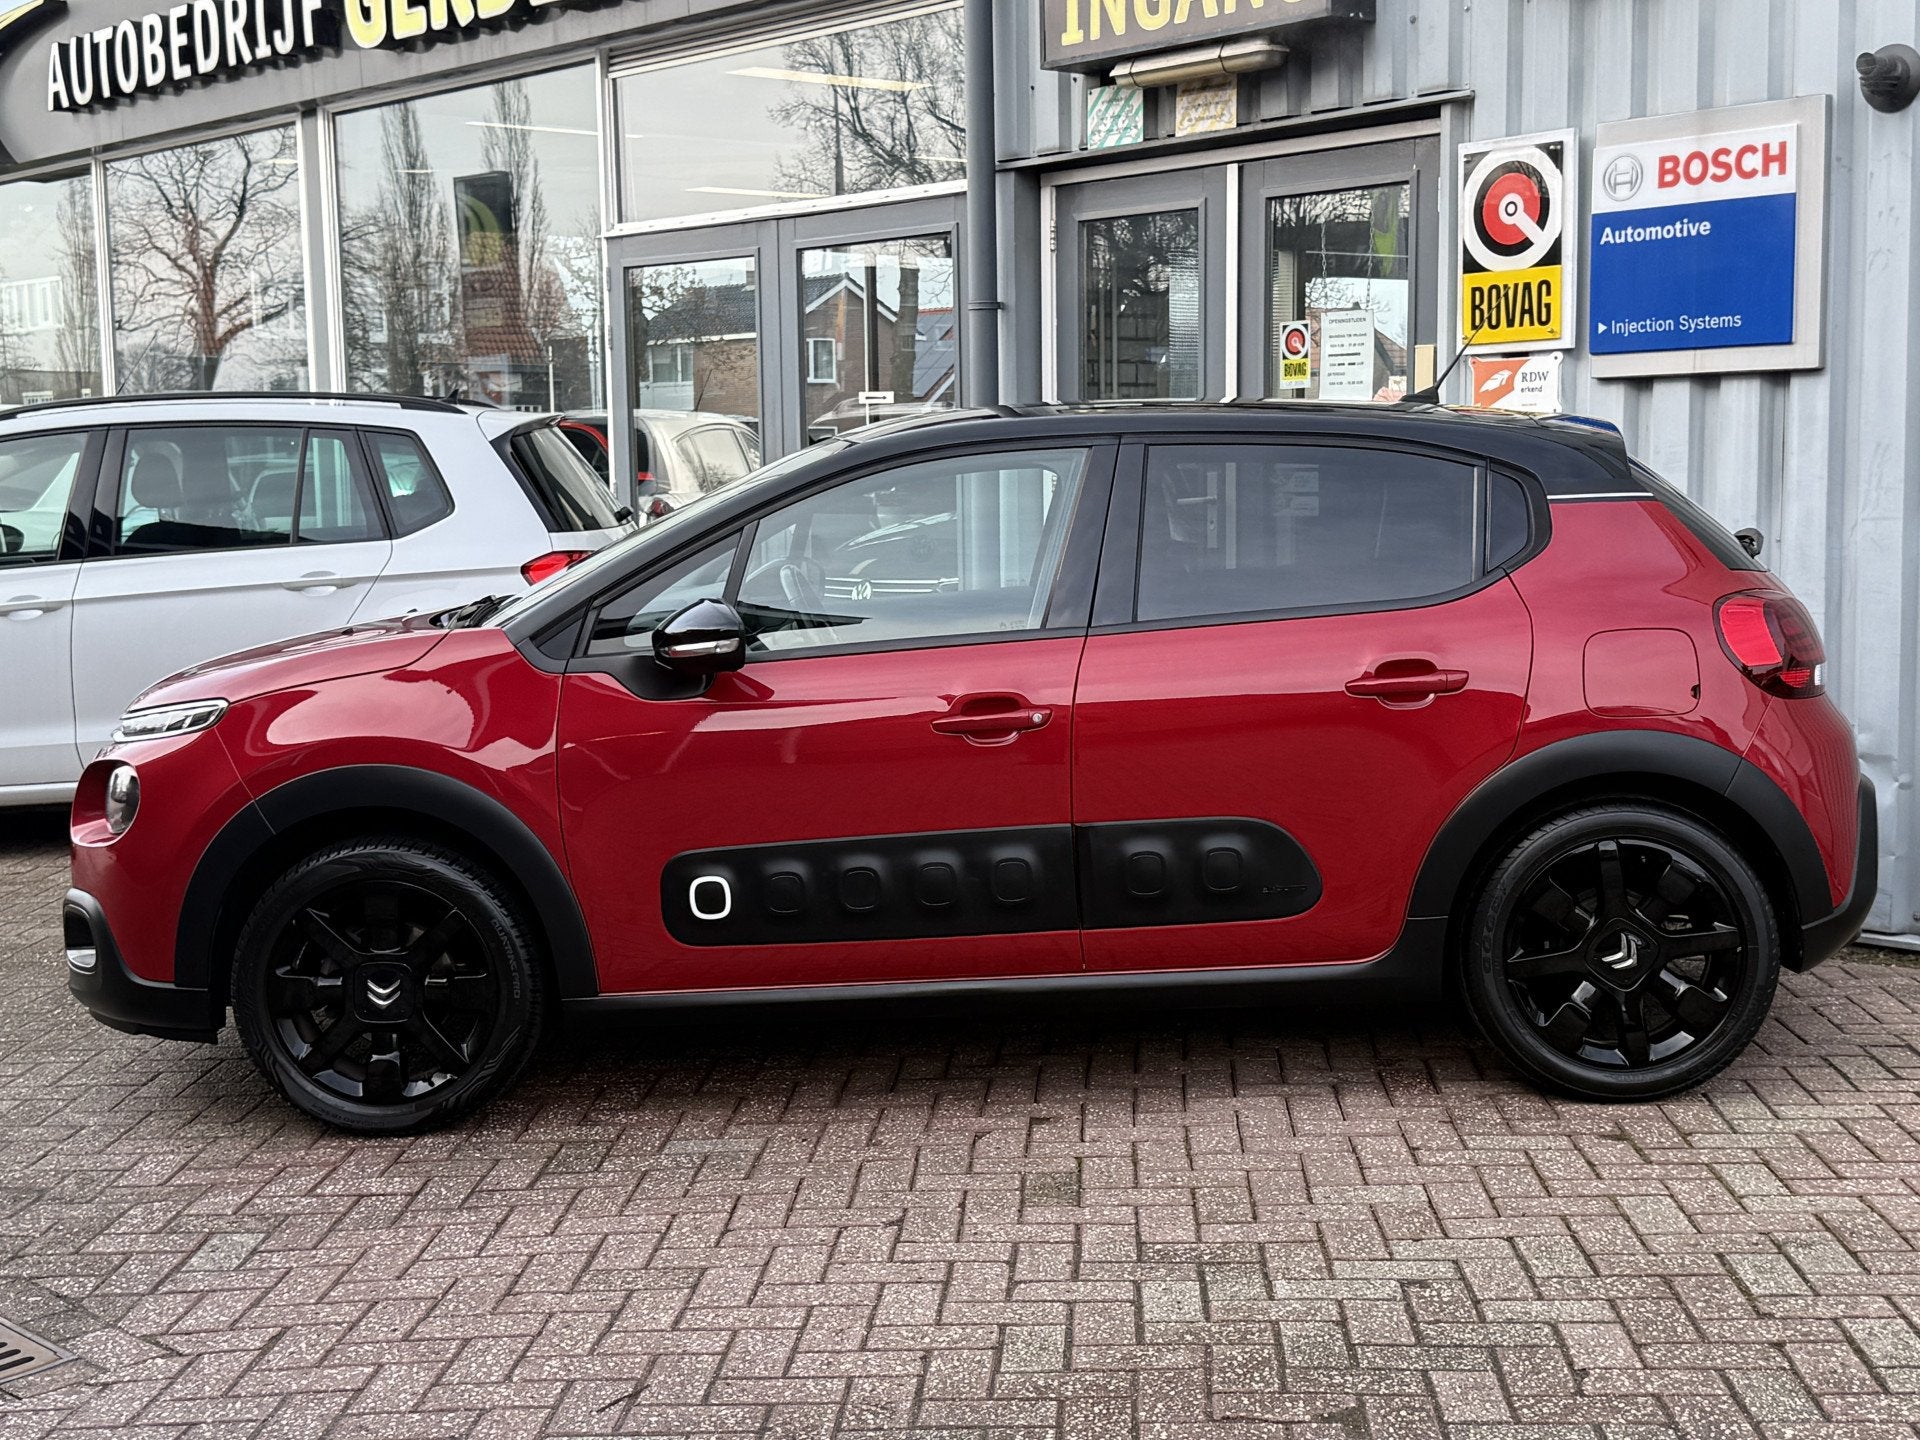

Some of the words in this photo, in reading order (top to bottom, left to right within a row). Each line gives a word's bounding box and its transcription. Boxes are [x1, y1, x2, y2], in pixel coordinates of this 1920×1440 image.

[47, 0, 322, 112] AUTOBEDRIJF
[1657, 140, 1787, 189] BOSCH
[1599, 218, 1711, 245] Automotive
[1470, 279, 1552, 331] BOVAG
[1611, 317, 1674, 337] Injection
[1679, 314, 1742, 333] Systems
[1284, 361, 1307, 377] BOVAG
[1521, 371, 1549, 382] RDW
[1520, 385, 1543, 393] erkend
